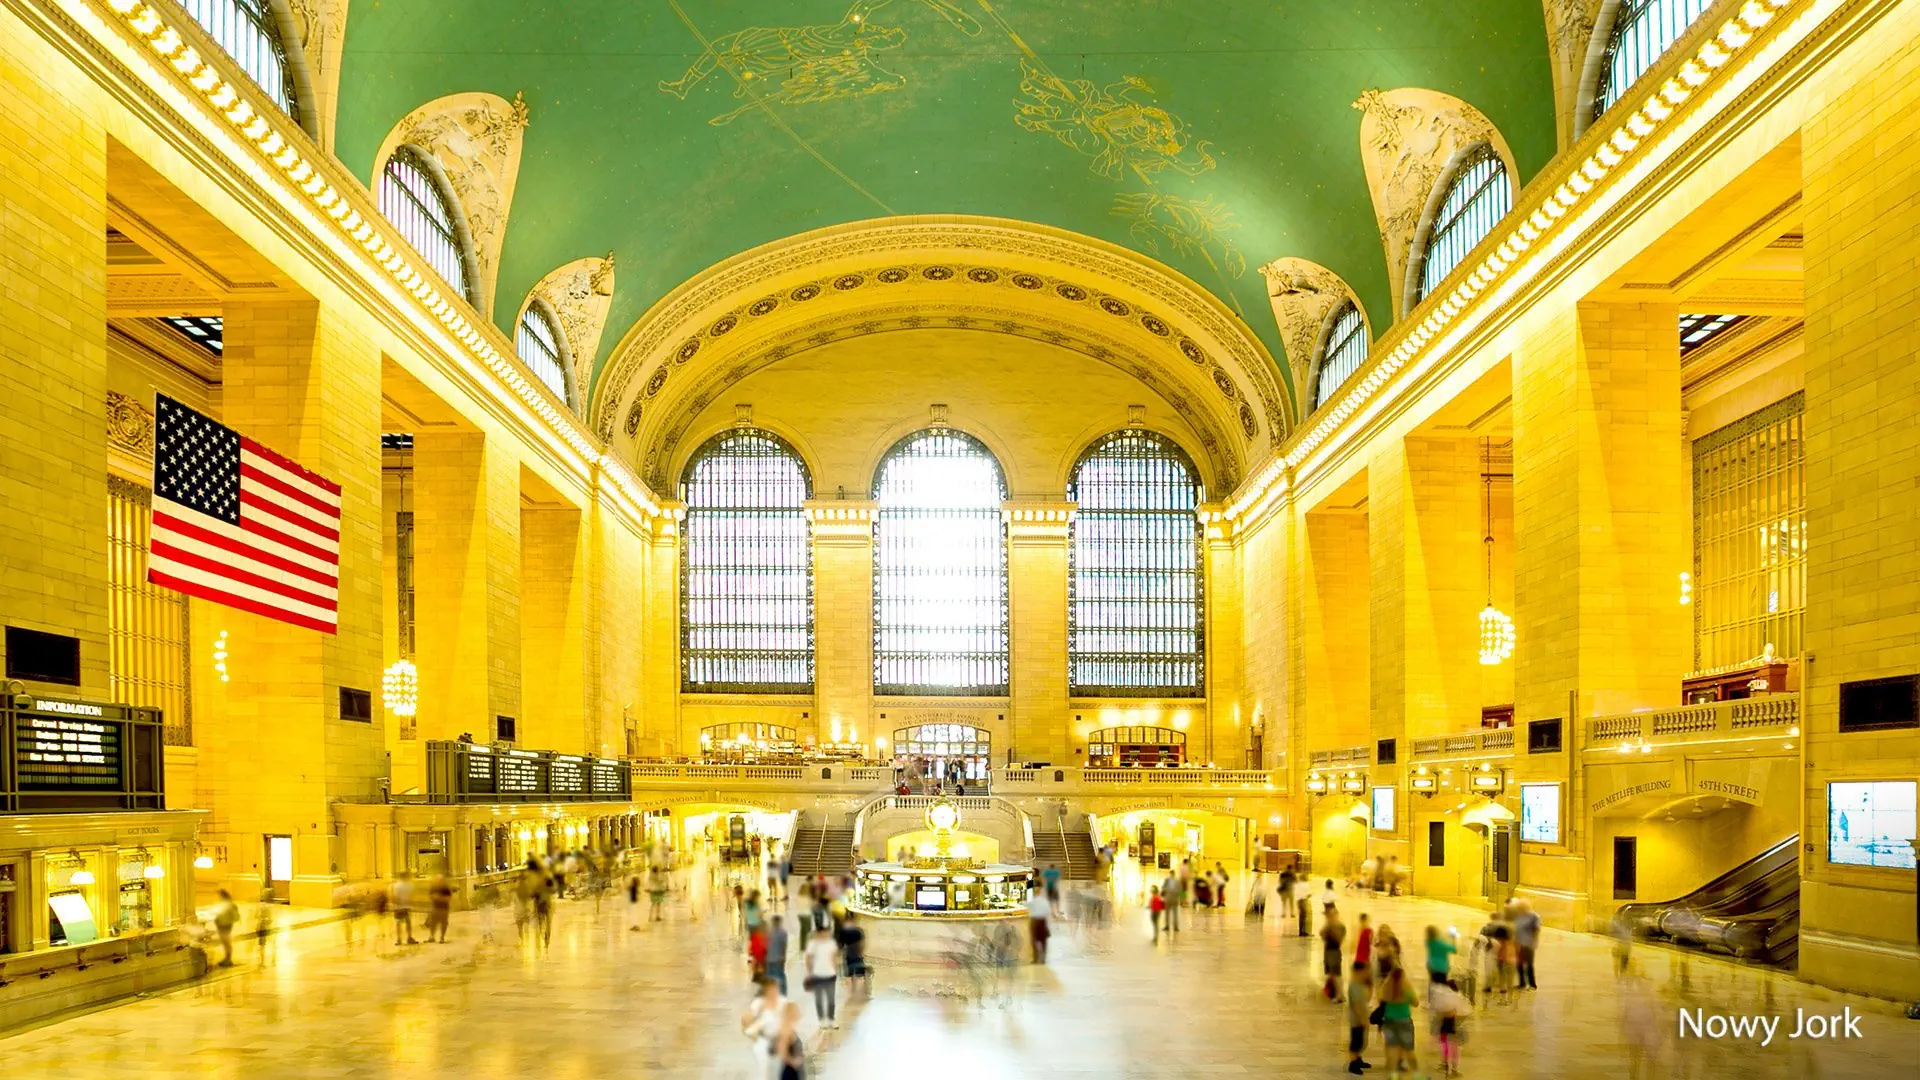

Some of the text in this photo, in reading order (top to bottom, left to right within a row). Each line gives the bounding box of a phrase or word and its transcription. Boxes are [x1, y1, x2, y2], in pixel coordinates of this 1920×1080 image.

[36, 699, 103, 716] INFORMATION
[1591, 779, 1671, 812] THE METLIFE BUILDING
[1698, 780, 1760, 800] 45TH STREET
